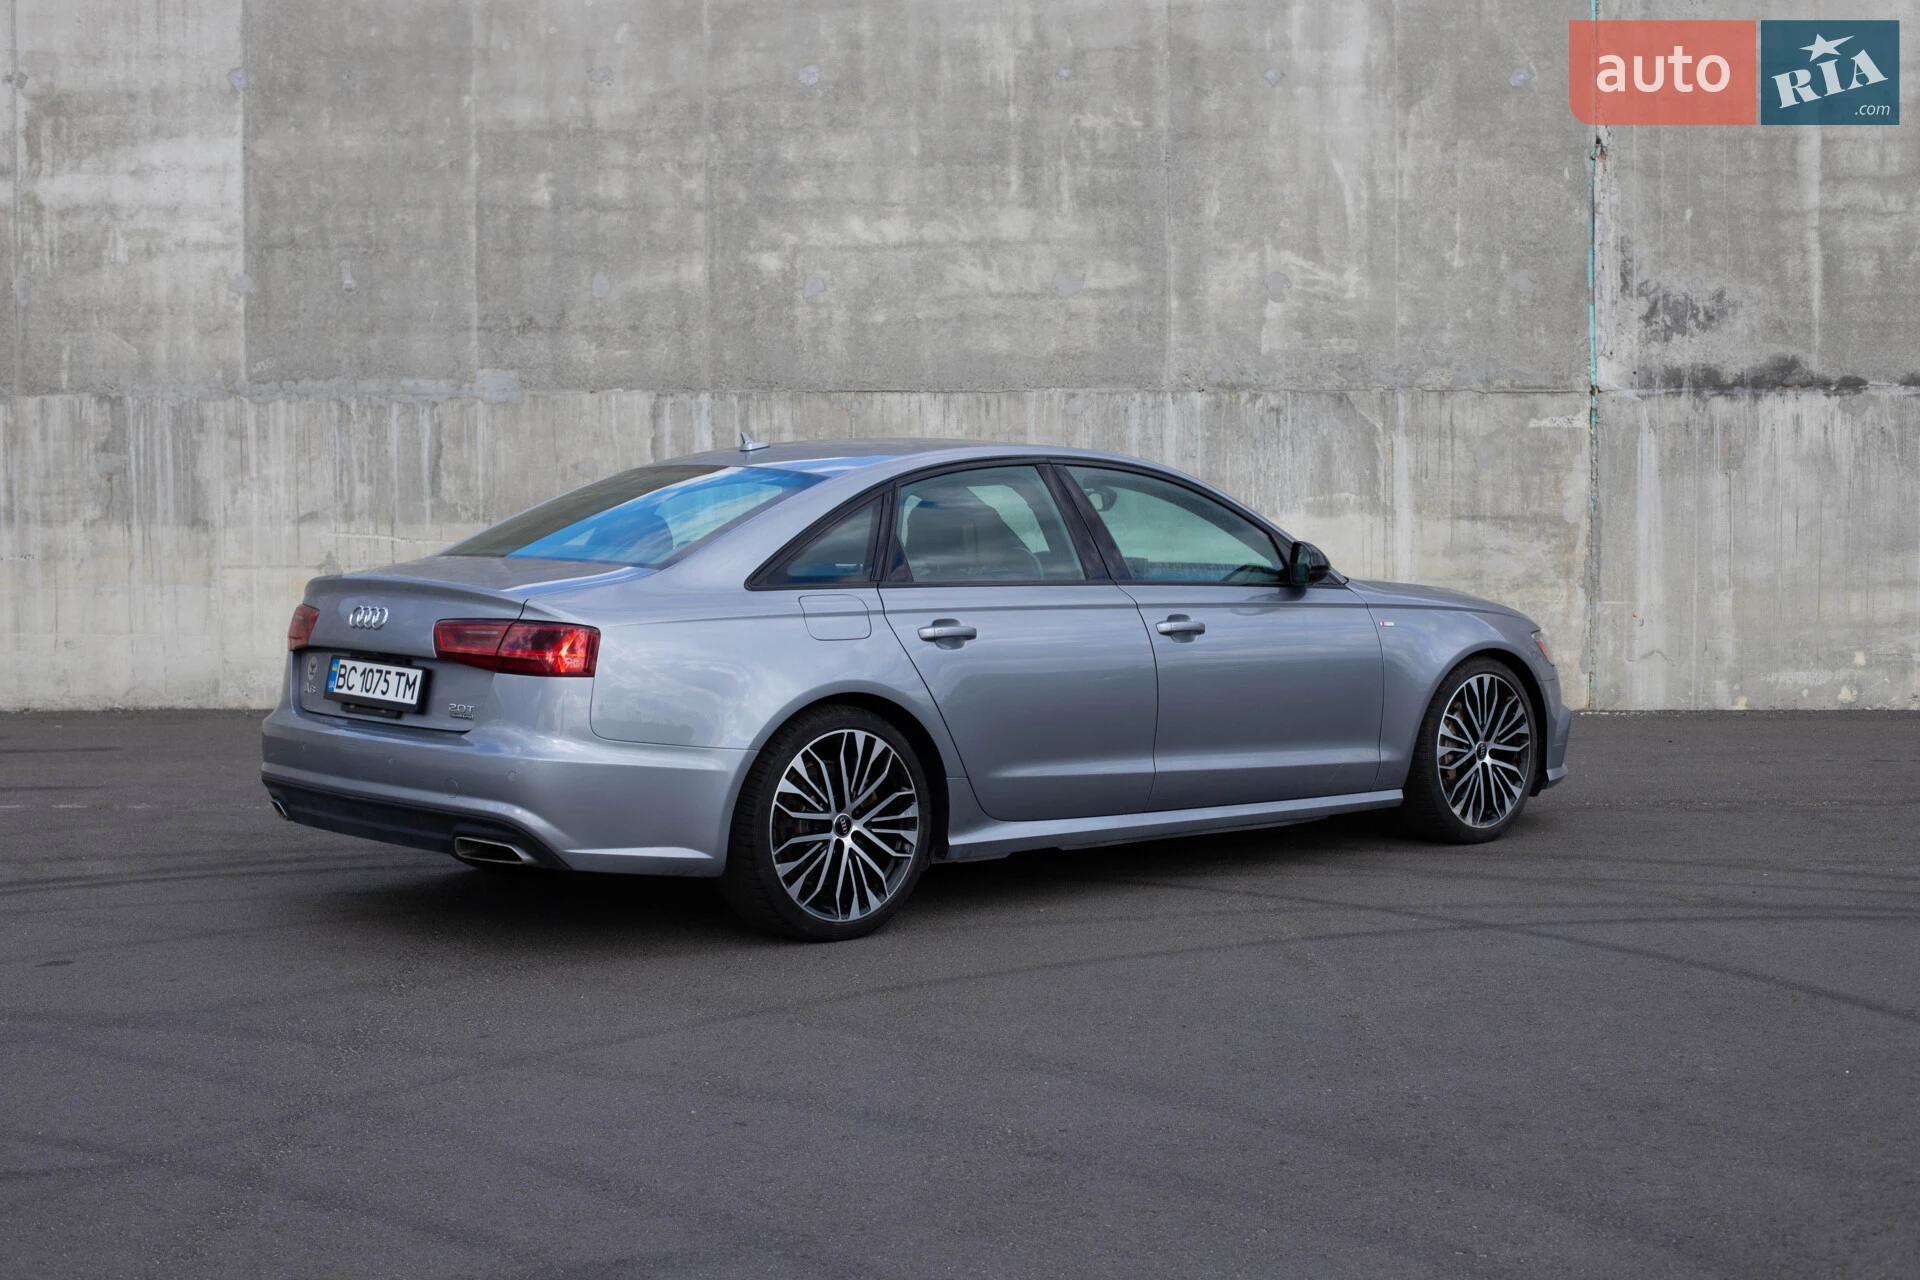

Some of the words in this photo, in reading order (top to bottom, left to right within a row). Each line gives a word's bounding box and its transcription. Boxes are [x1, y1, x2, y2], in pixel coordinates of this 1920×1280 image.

[336, 664, 358, 691] BC
[360, 667, 392, 696] 1075
[395, 671, 418, 700] TM
